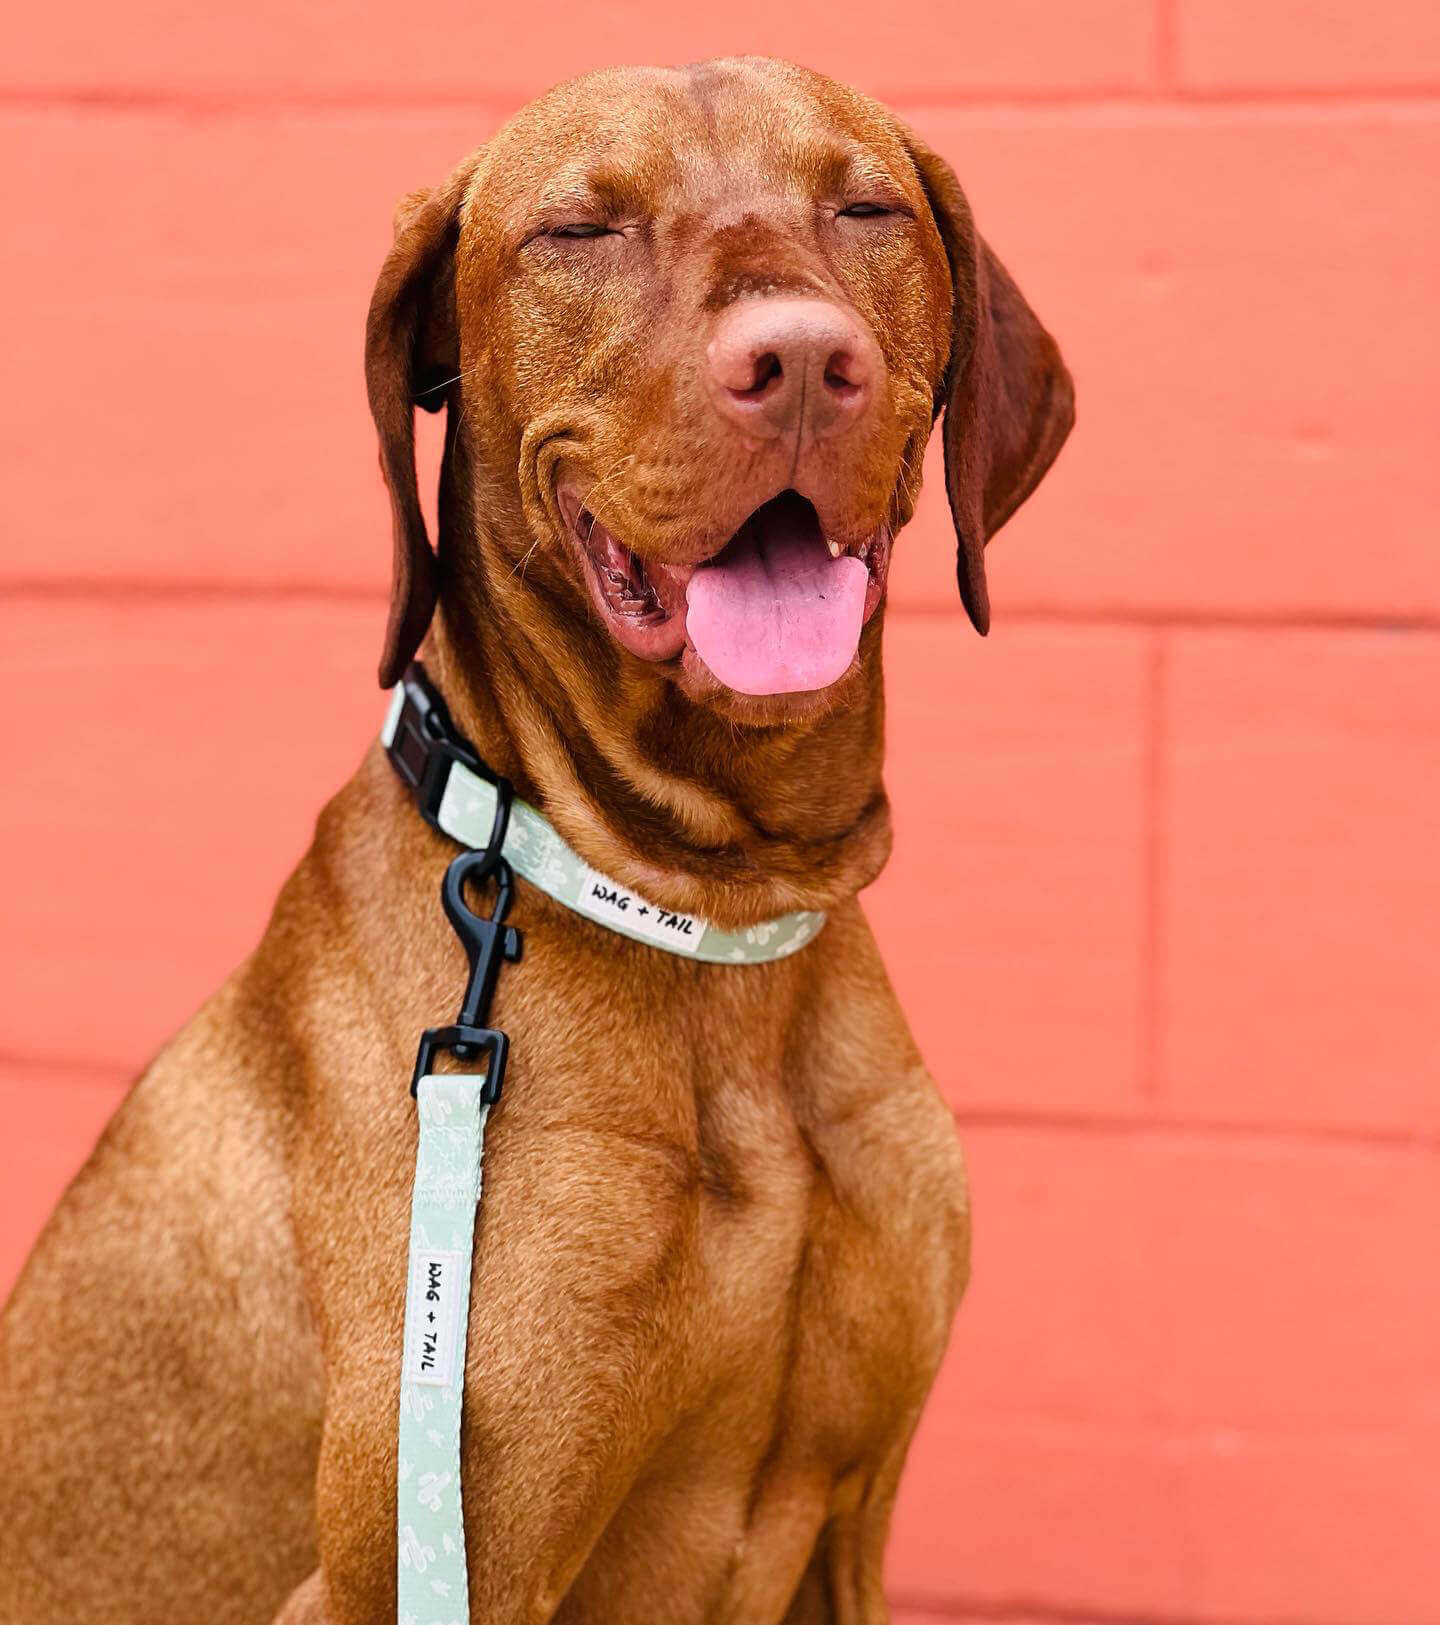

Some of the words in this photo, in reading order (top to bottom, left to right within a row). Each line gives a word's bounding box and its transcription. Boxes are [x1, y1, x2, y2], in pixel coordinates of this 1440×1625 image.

[592, 884, 630, 912] WAG
[638, 906, 649, 917] +
[656, 910, 693, 935] TAIL
[425, 1262, 442, 1302] WAG
[426, 1311, 436, 1323] +
[421, 1332, 437, 1371] TAIL
